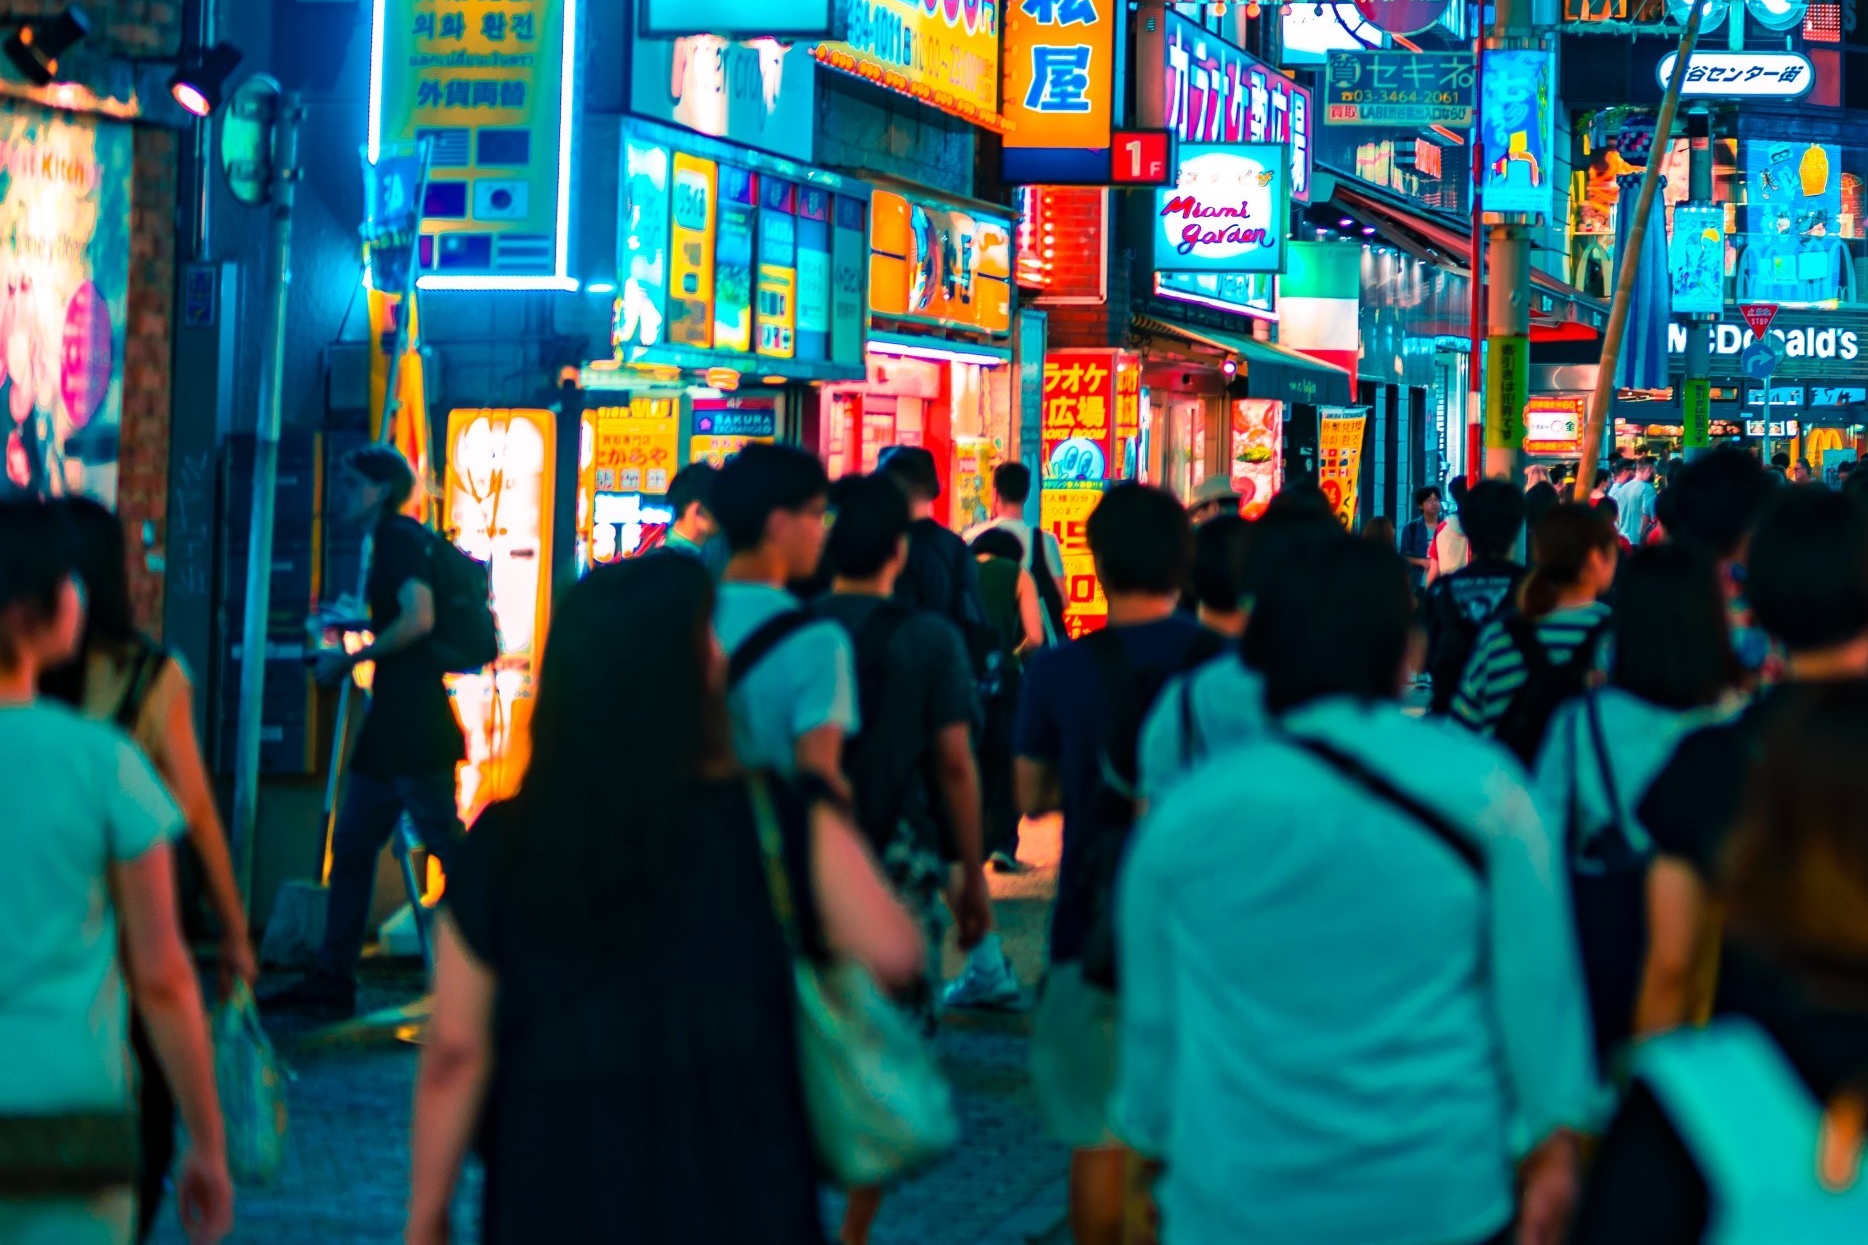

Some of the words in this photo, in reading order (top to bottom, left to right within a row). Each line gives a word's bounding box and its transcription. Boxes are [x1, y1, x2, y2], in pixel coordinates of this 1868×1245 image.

[1366, 55, 1474, 89] セキネ
[1354, 90, 1459, 104] 03-3464-2061
[1330, 105, 1358, 120] 買取
[1125, 139, 1162, 178] 1F
[1160, 196, 1251, 220] Miami
[1747, 307, 1772, 317] 止まれ
[1751, 318, 1769, 326] STOP
[1043, 395, 1106, 429] 広場
[714, 414, 772, 426] SAKURA
